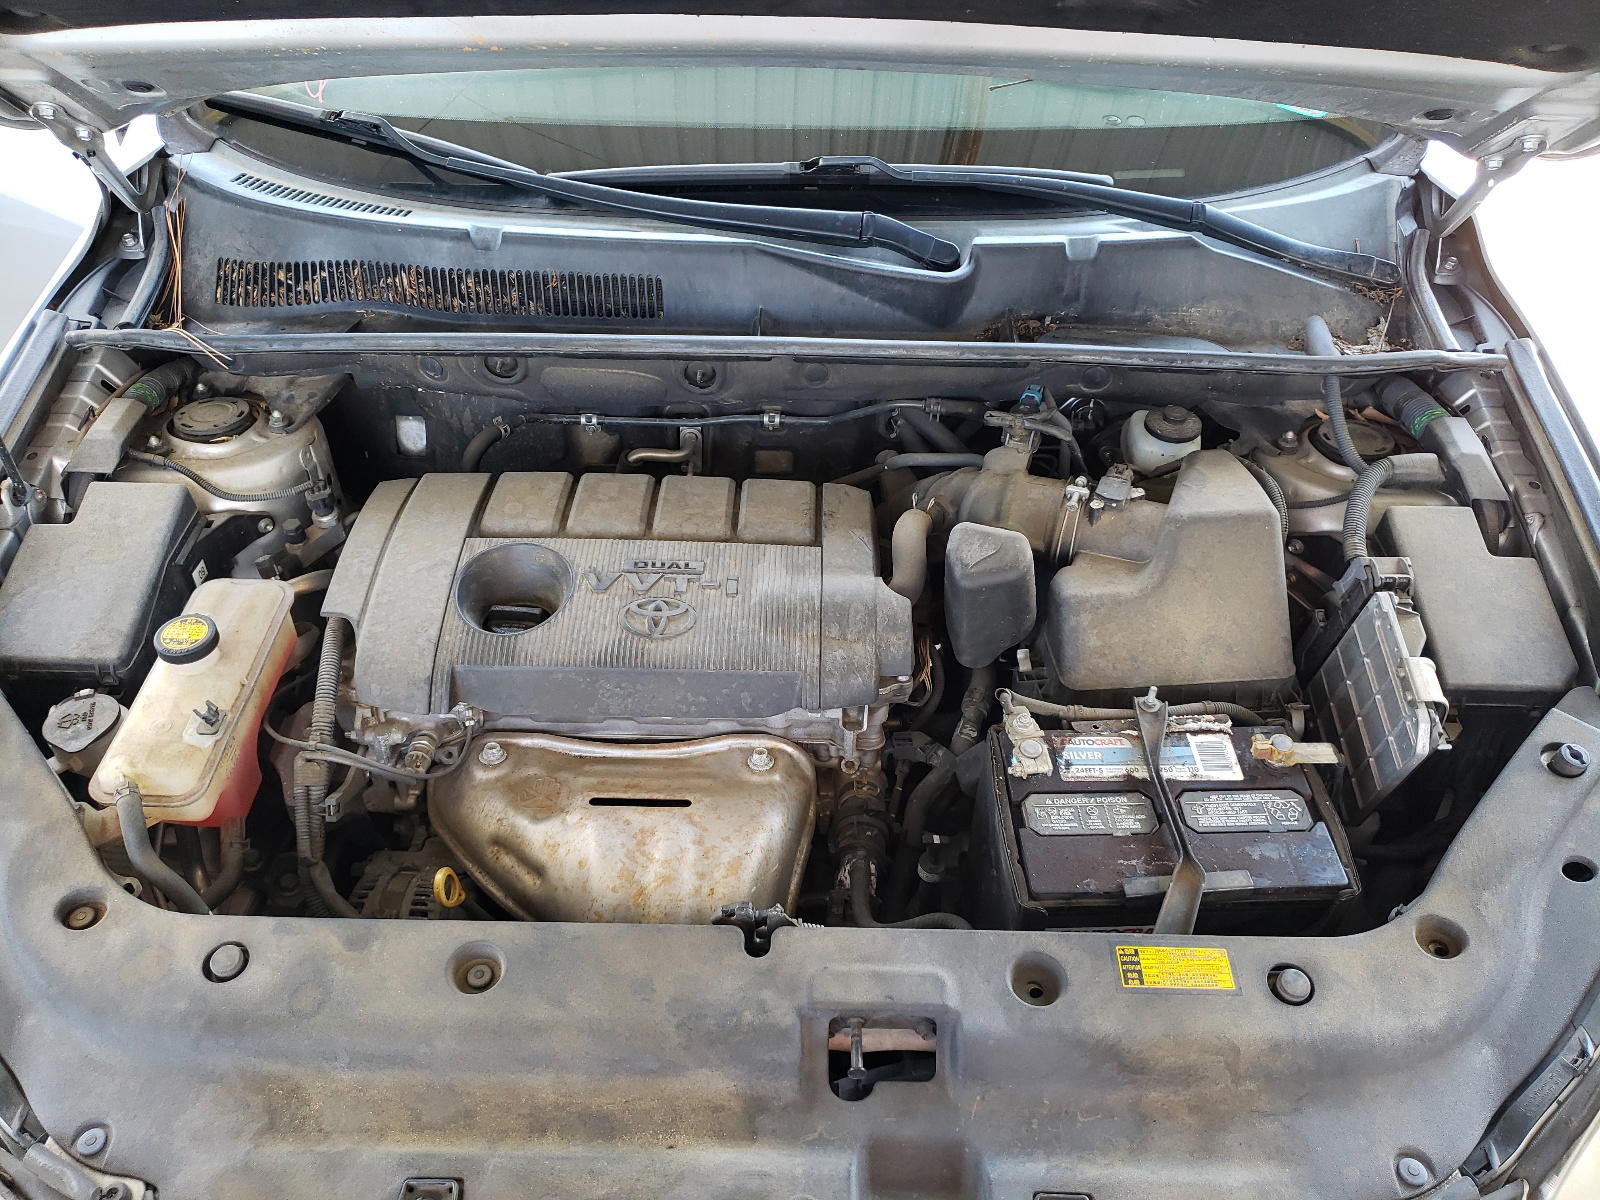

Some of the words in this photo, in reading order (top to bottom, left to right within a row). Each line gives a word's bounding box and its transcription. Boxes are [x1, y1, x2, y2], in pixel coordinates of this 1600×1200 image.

[633, 560, 697, 570] DUAL
[1069, 738, 1124, 746] AUTOCRAFT
[1063, 751, 1103, 760] SILVER
